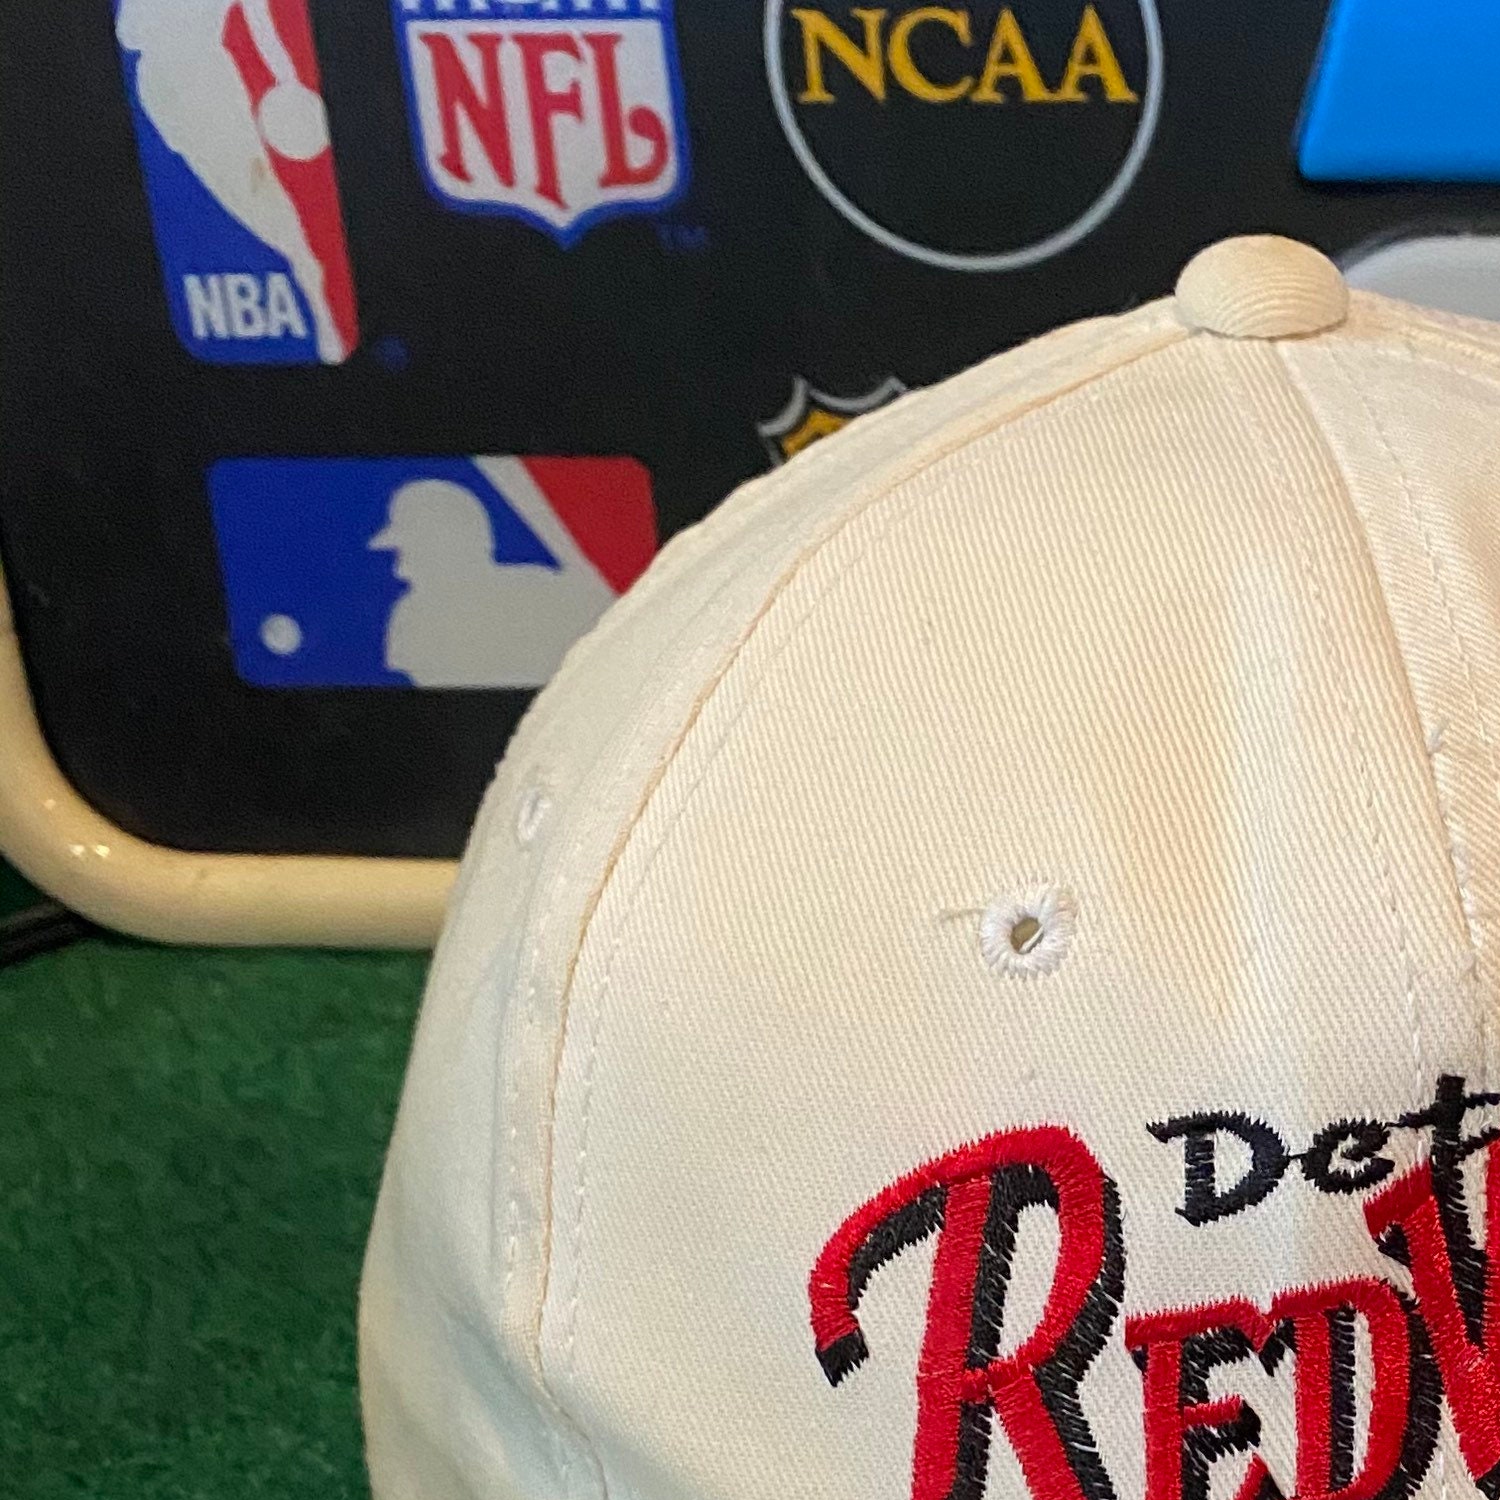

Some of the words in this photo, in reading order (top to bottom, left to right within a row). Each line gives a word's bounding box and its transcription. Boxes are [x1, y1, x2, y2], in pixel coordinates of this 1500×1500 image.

[792, 4, 1139, 104] NCAA
[418, 32, 669, 211] NFL
[183, 272, 308, 341] NBA
